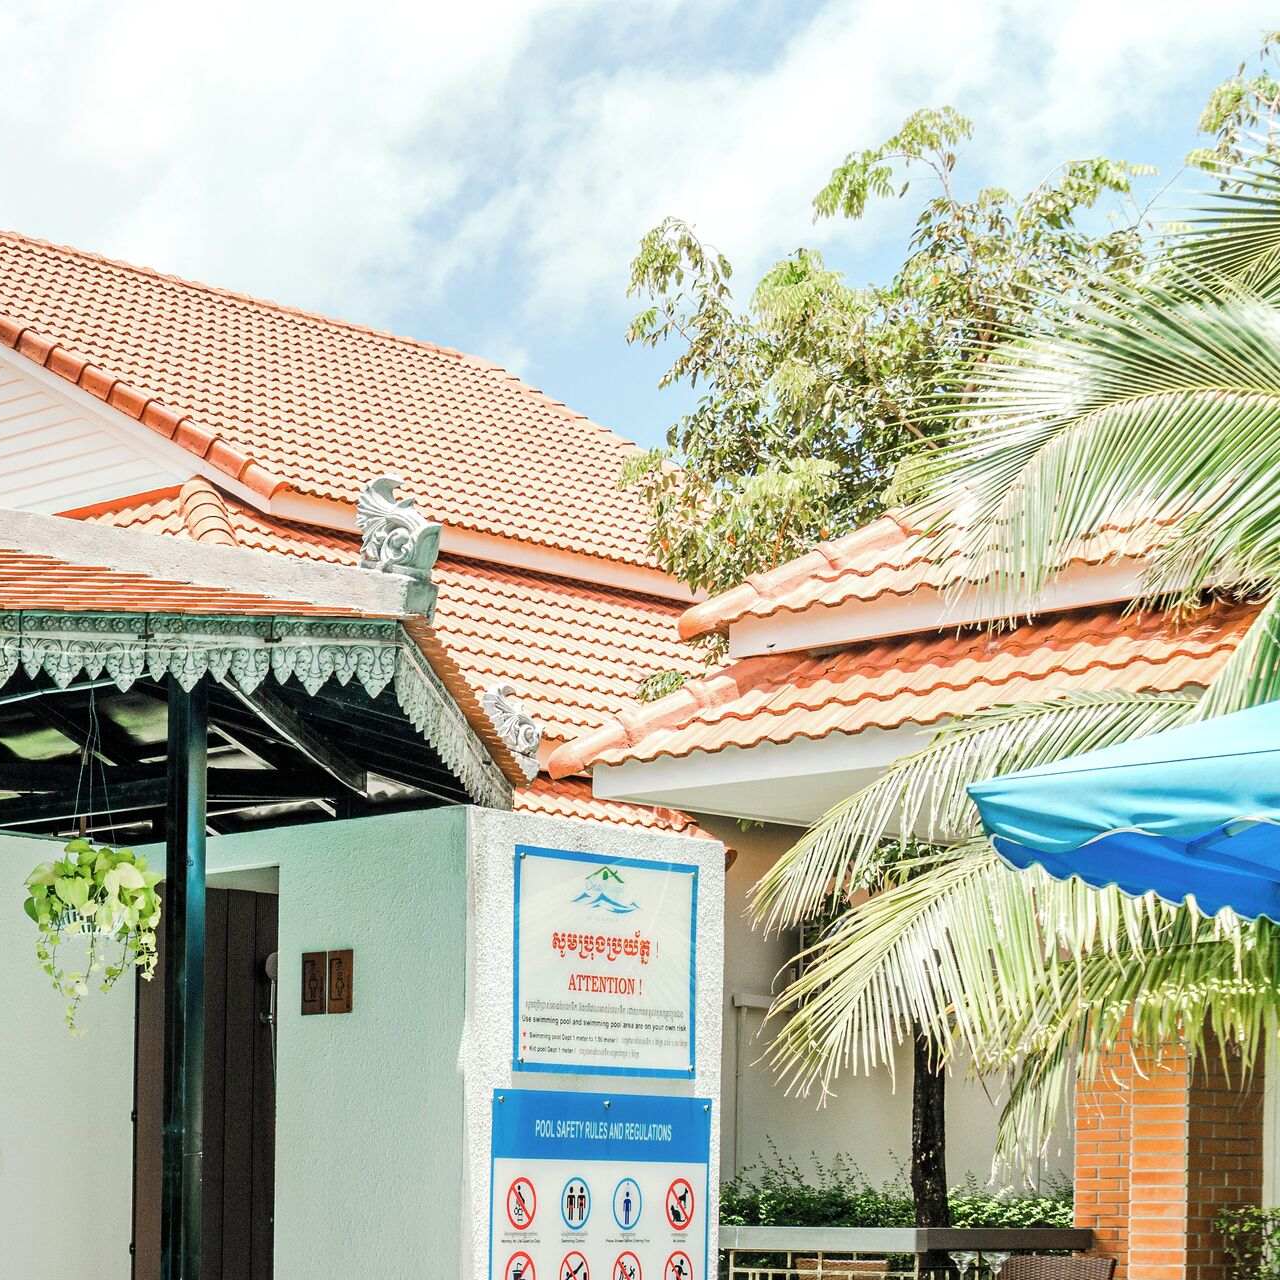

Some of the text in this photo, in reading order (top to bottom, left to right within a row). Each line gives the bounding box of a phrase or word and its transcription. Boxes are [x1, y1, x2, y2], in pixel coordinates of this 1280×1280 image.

[568, 974, 635, 995] ATTENTION
[522, 1014, 531, 1022] Use
[533, 1015, 559, 1026] swimming
[560, 1018, 571, 1026] pool
[572, 1018, 582, 1026] and
[583, 1019, 609, 1029] swimming
[610, 1020, 621, 1030] pool
[652, 1024, 664, 1032] your
[535, 1119, 672, 1142] POOL SAFETY RULES AND REGULATIONS
